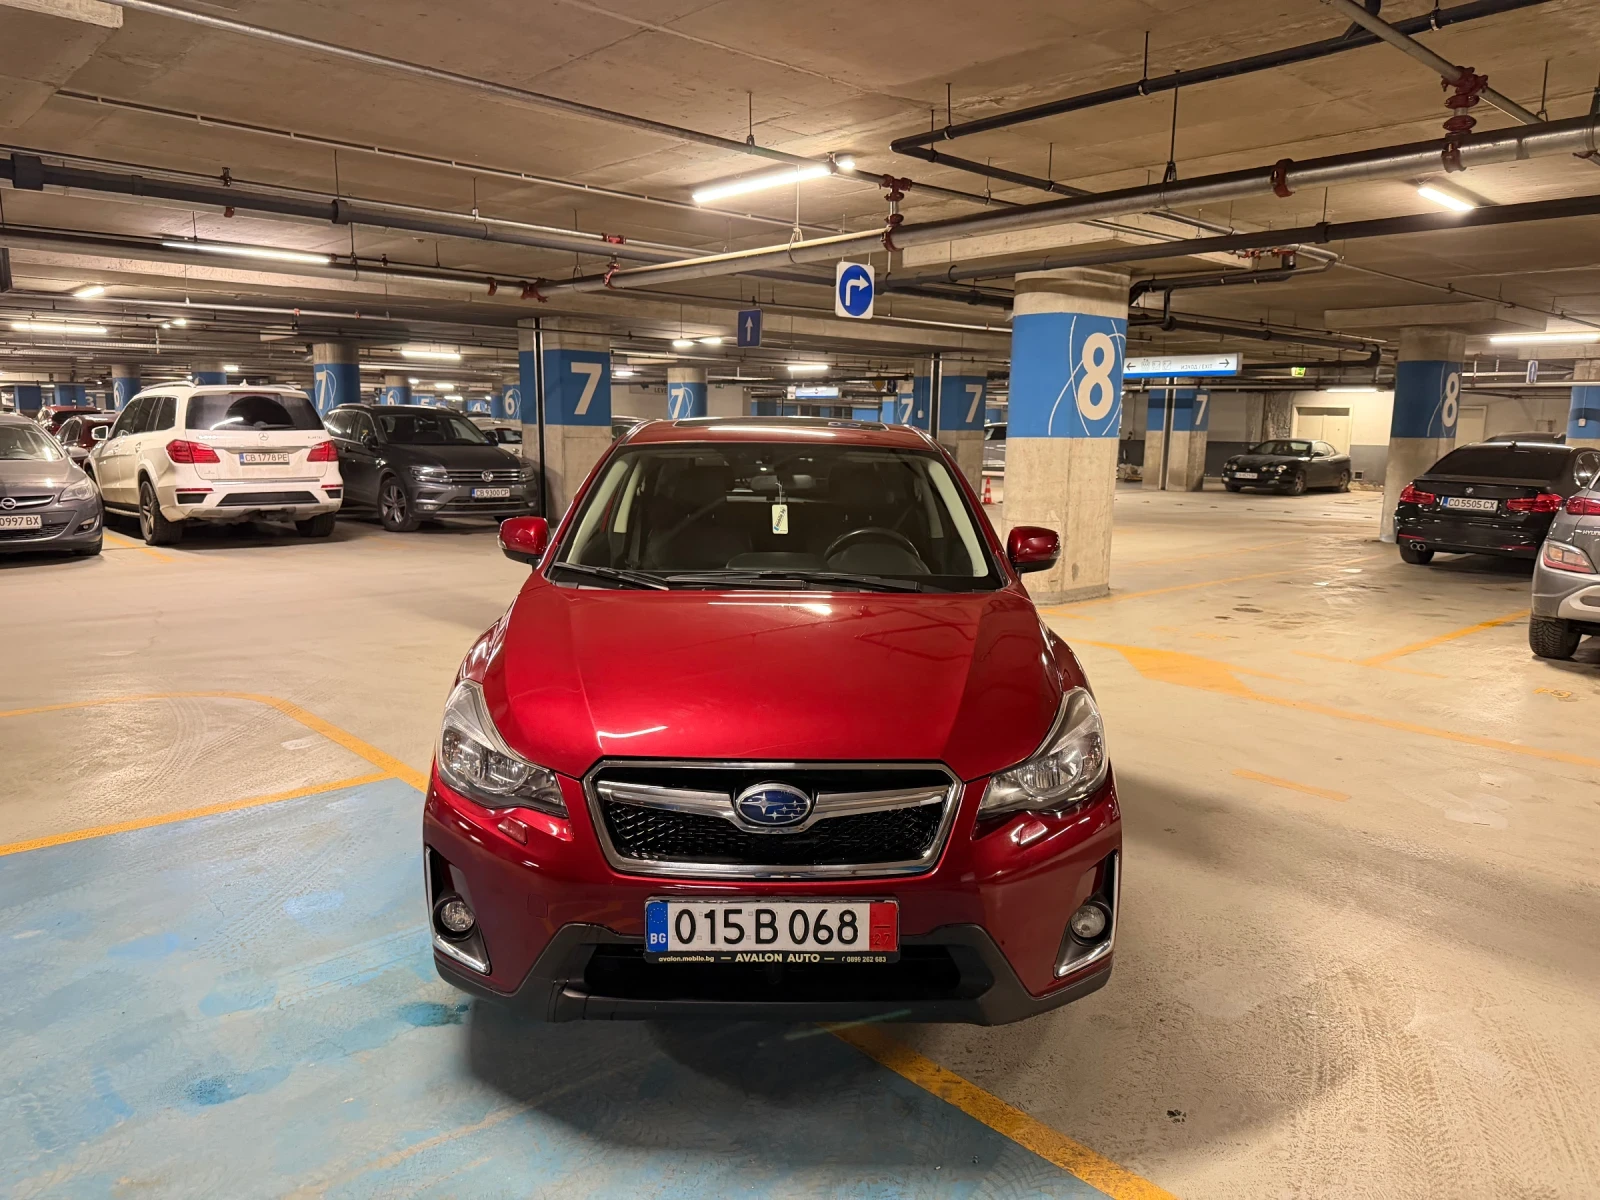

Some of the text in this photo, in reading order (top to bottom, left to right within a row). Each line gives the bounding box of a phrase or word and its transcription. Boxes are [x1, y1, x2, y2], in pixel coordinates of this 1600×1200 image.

[571, 361, 603, 415] 7
[1078, 332, 1116, 420] 8
[316, 370, 327, 410] 7
[505, 388, 515, 415] 6
[671, 388, 685, 419] 7
[966, 384, 983, 423] 7
[1442, 372, 1459, 427] 8
[901, 398, 914, 423] 7
[1195, 394, 1209, 425] 7
[245, 453, 288, 462] CB 1778 PE
[1461, 499, 1482, 508] 5505
[1483, 501, 1496, 510] CX
[26, 516, 40, 526] BX
[650, 932, 667, 944] BG
[674, 908, 859, 945] 015 B 068
[873, 932, 891, 946] 27
[658, 955, 715, 963] avalon.mobile.bg
[735, 953, 821, 963] AVALON AUTO
